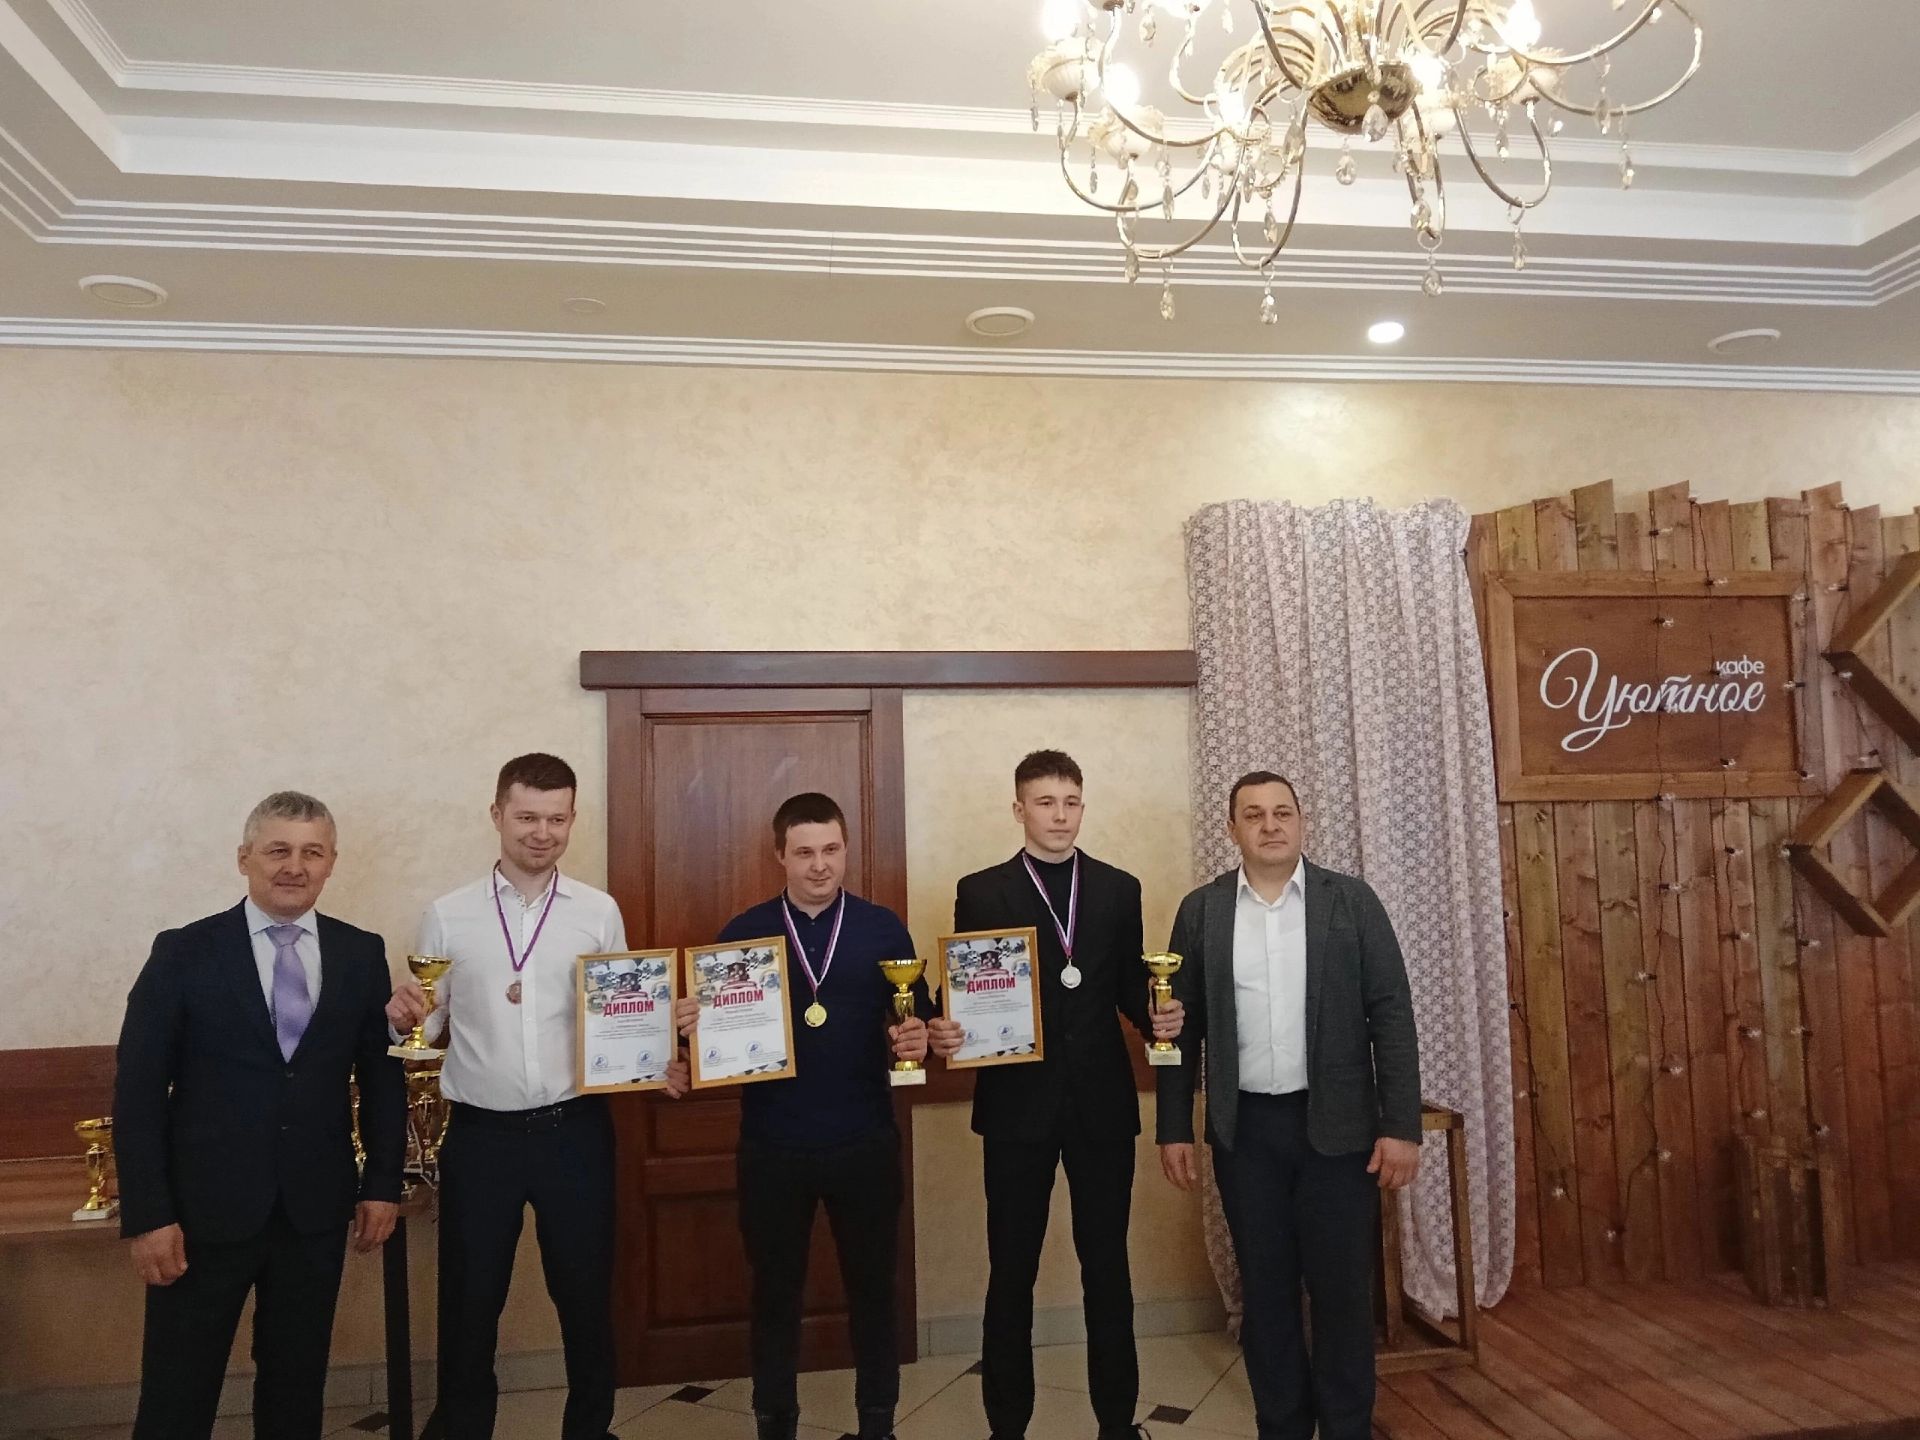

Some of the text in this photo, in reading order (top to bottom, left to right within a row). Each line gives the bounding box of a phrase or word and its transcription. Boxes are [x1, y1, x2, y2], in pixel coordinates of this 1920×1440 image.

[1715, 654, 1765, 679] кафе
[1540, 647, 1766, 752] Уютное
[967, 977, 1016, 994] ДИПЛОМ
[603, 1000, 654, 1017] ДИПЛОМ
[712, 989, 764, 1009] ДИПЛОМ
